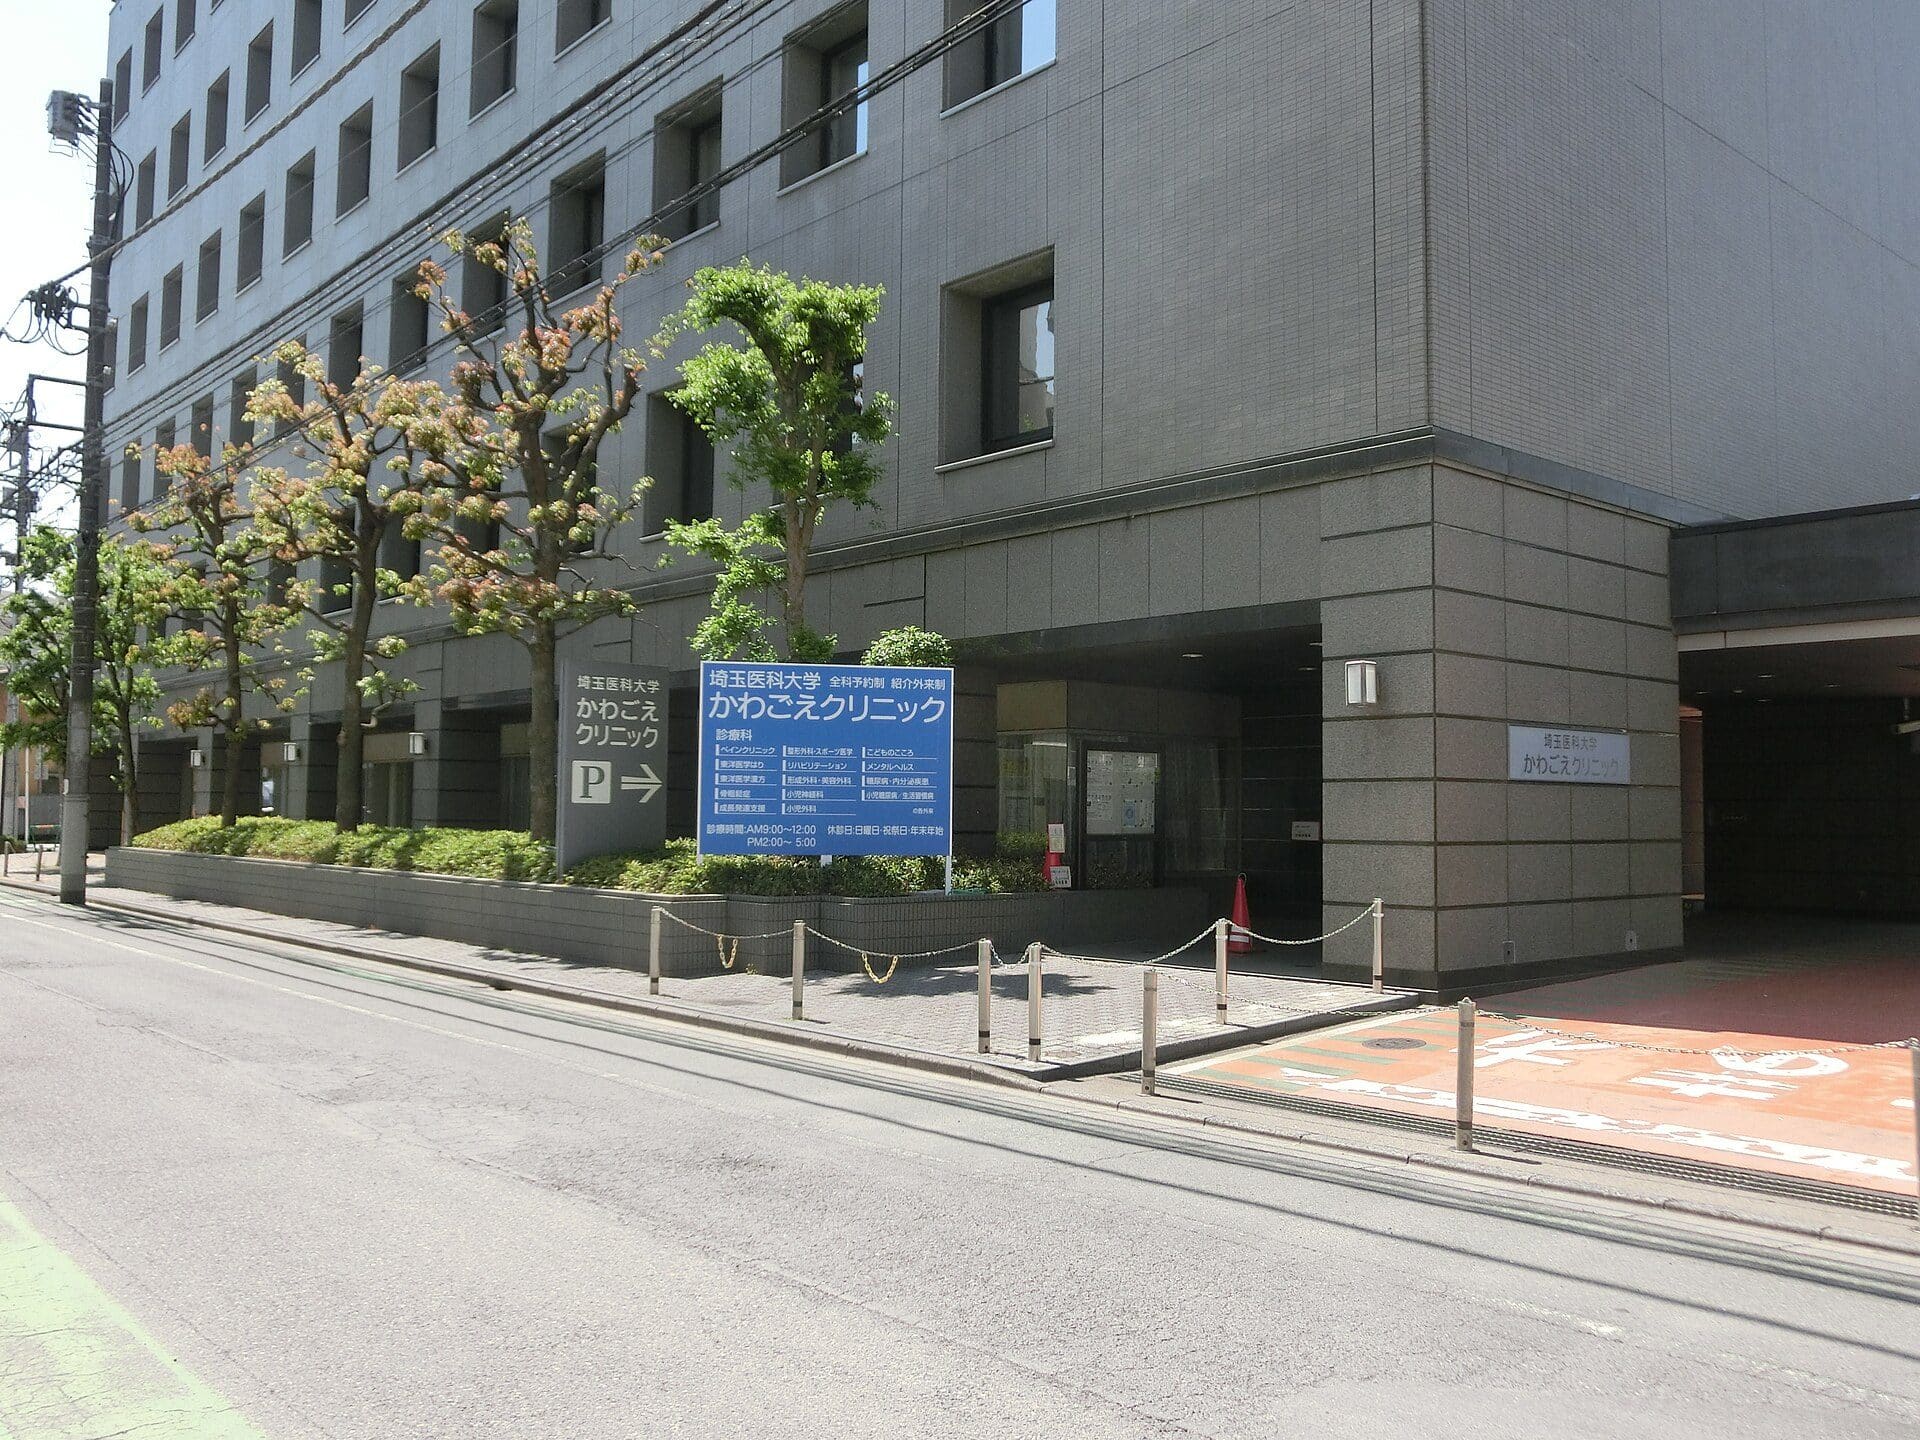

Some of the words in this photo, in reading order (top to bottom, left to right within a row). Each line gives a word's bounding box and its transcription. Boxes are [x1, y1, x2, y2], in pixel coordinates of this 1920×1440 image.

[576, 675, 660, 694] 埼玉医科大学
[709, 669, 821, 690] 埼玉医科大学
[829, 676, 885, 689] 全科予約制
[891, 677, 946, 691] 紹介外来制
[576, 697, 660, 722] かわごえ
[708, 691, 946, 723] かわごえクリニック
[575, 723, 659, 749] クリニック
[715, 729, 753, 741] 診療科
[1543, 732, 1598, 751] 埼玉医科大学
[720, 746, 776, 755] ペインクリニック
[866, 749, 914, 758] こどものこころ
[787, 761, 848, 770] リハビリテーション
[866, 763, 915, 771] メンタルヘルス
[1523, 753, 1620, 778] かわごえクリニック
[579, 765, 605, 799] P
